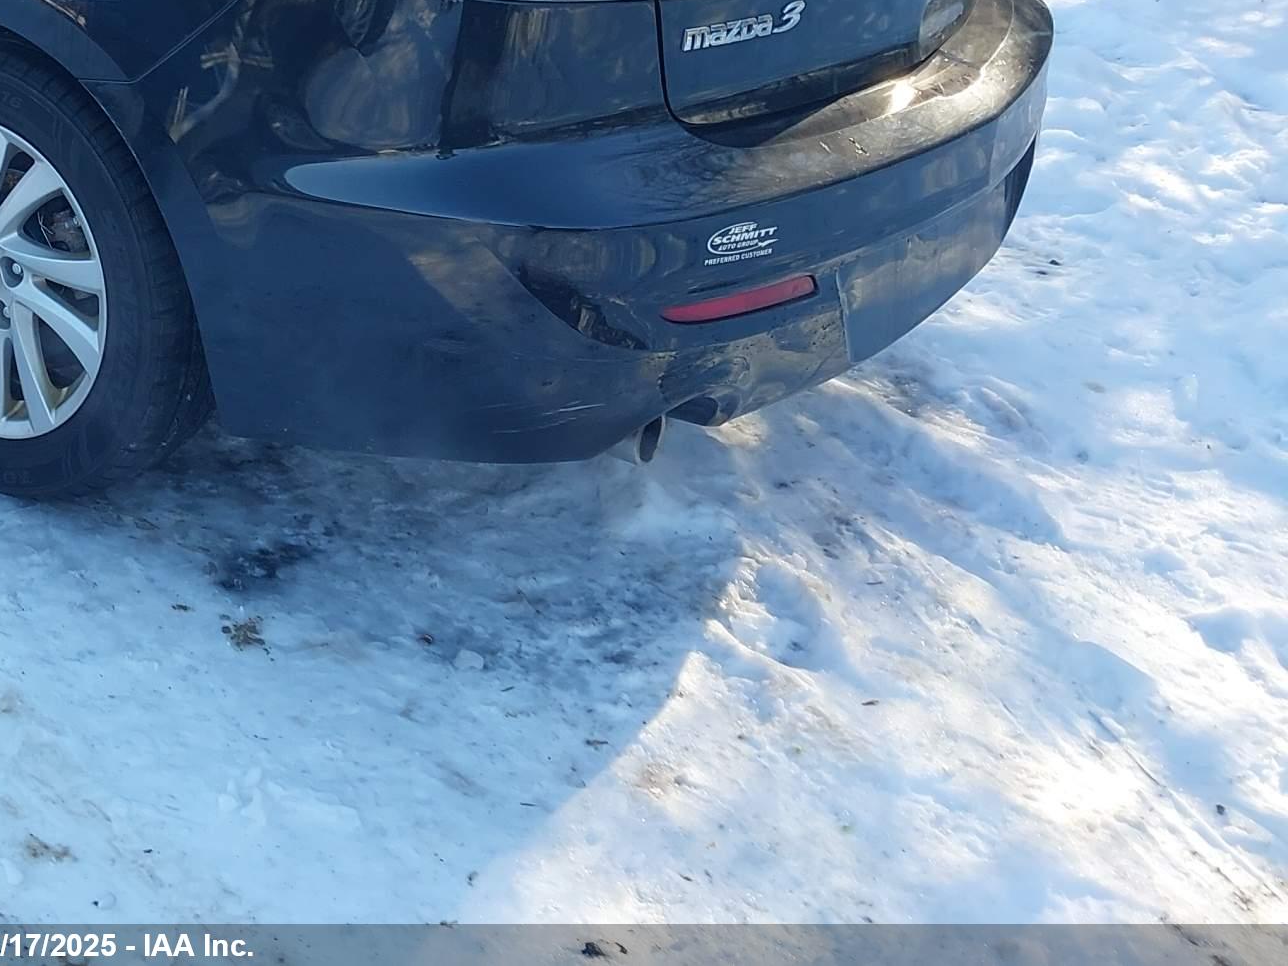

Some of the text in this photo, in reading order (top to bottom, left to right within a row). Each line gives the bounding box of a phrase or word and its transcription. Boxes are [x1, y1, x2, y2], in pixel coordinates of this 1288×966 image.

[712, 226, 778, 245] SCHMITT
[728, 223, 758, 235] JEFF
[718, 239, 759, 251] AUTO GROUP
[704, 248, 773, 266] PREFERRED CUSTOMER
